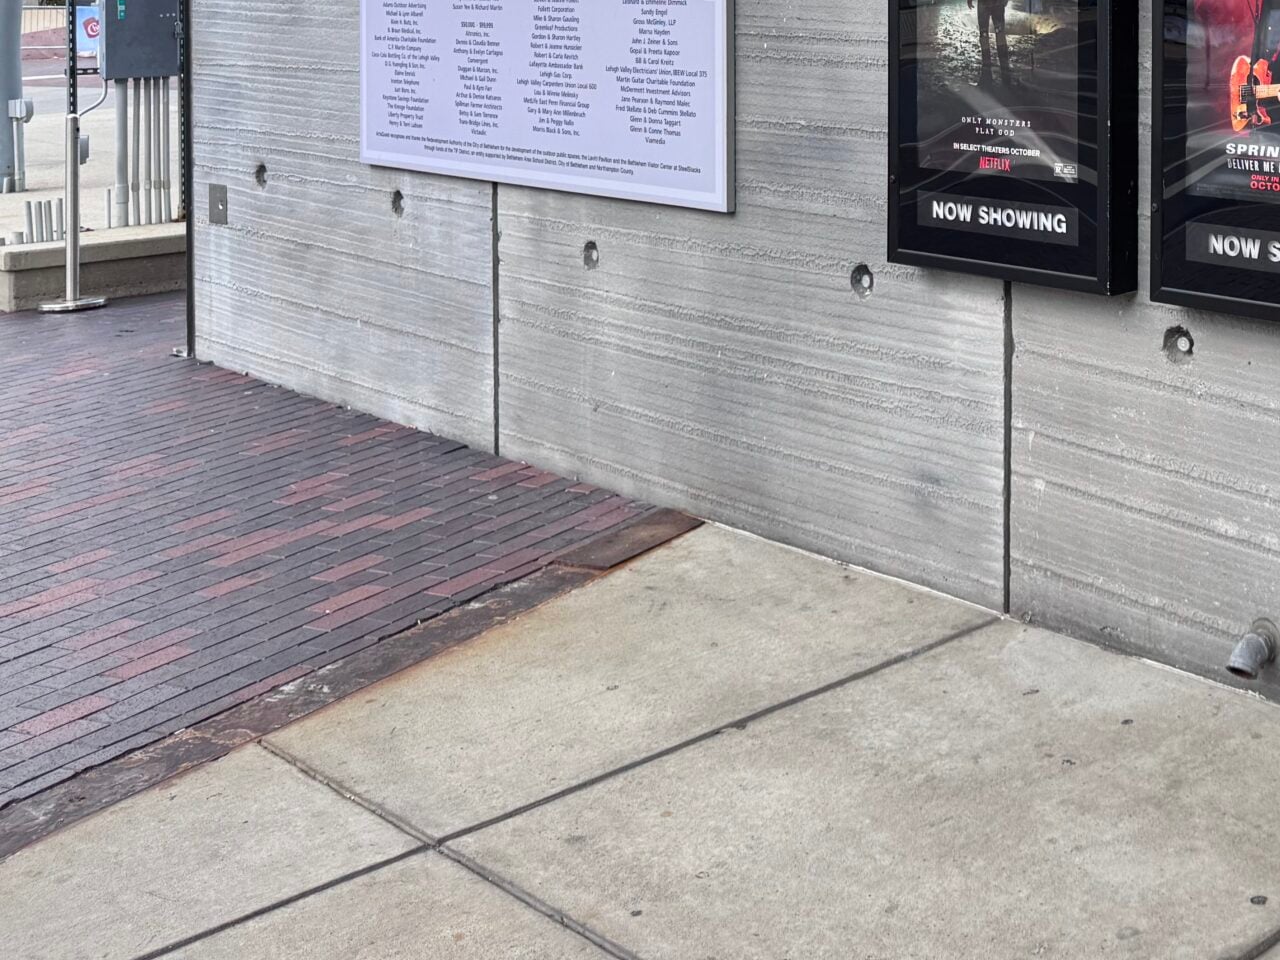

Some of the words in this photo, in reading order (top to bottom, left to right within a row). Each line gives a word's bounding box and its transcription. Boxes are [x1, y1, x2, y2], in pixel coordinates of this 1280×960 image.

[961, 117, 982, 125] ONLY
[986, 118, 1031, 128] MONSTERS
[975, 127, 994, 135] PLAY
[998, 128, 1015, 137] GOD
[953, 142, 960, 150] IN
[960, 143, 980, 152] SELECT
[982, 144, 1010, 155] THEATERS
[1010, 147, 1041, 157] OCTOBER
[979, 156, 1011, 172] NETFLIX
[1227, 158, 1259, 172] DELIVER
[1263, 161, 1275, 173] ME
[932, 200, 973, 222] NOW
[978, 205, 1067, 234] SHOWING
[1208, 233, 1261, 259] NOW
